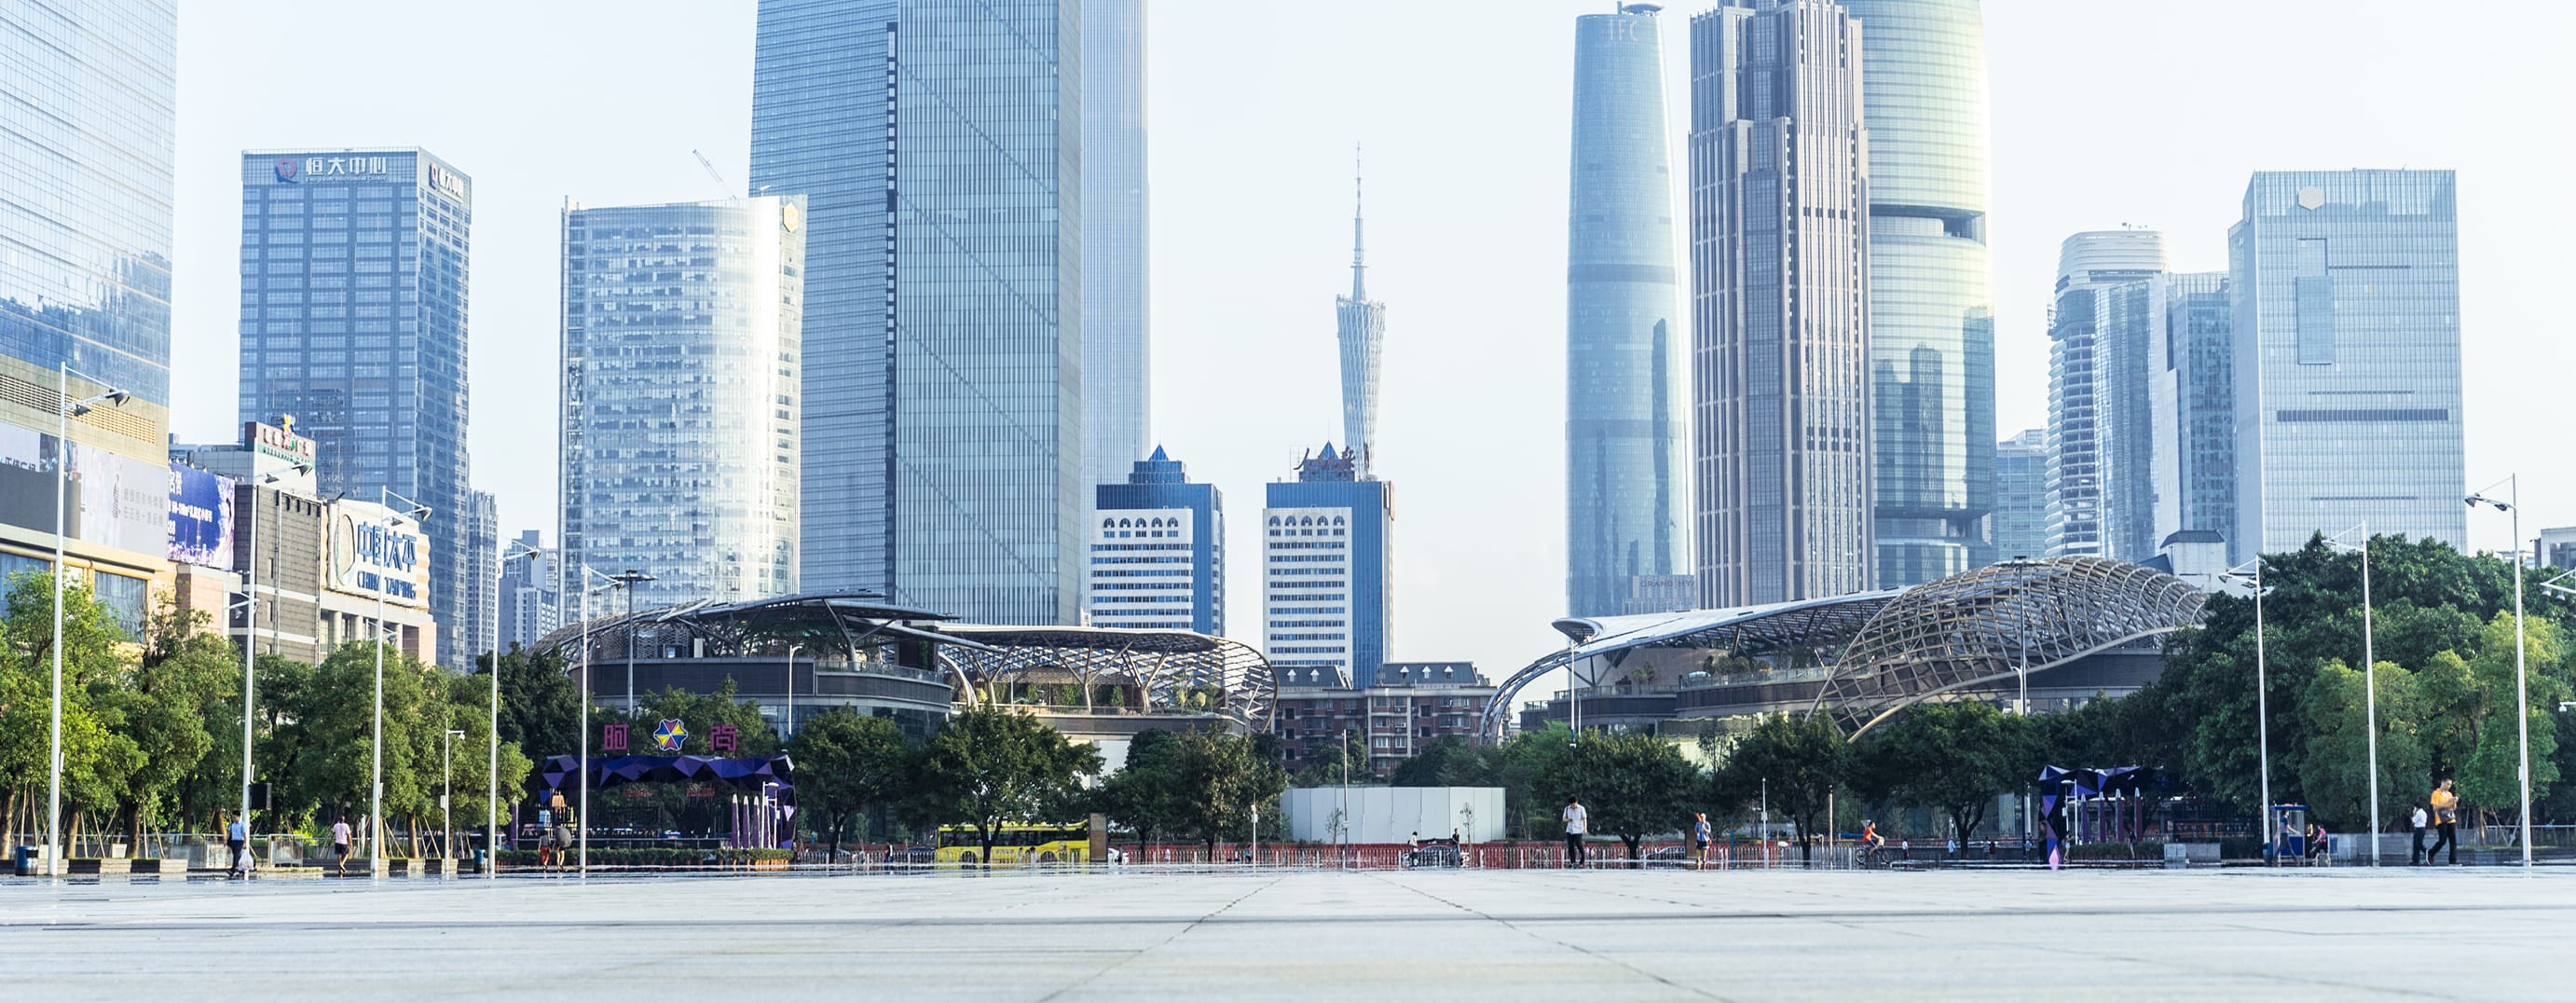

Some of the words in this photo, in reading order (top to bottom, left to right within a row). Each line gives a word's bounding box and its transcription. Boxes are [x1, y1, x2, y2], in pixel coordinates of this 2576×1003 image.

[1610, 19, 1638, 42] IFC
[306, 157, 387, 175] 恒大中心
[357, 521, 417, 572] 中国太平
[384, 576, 417, 599] TAIPING
